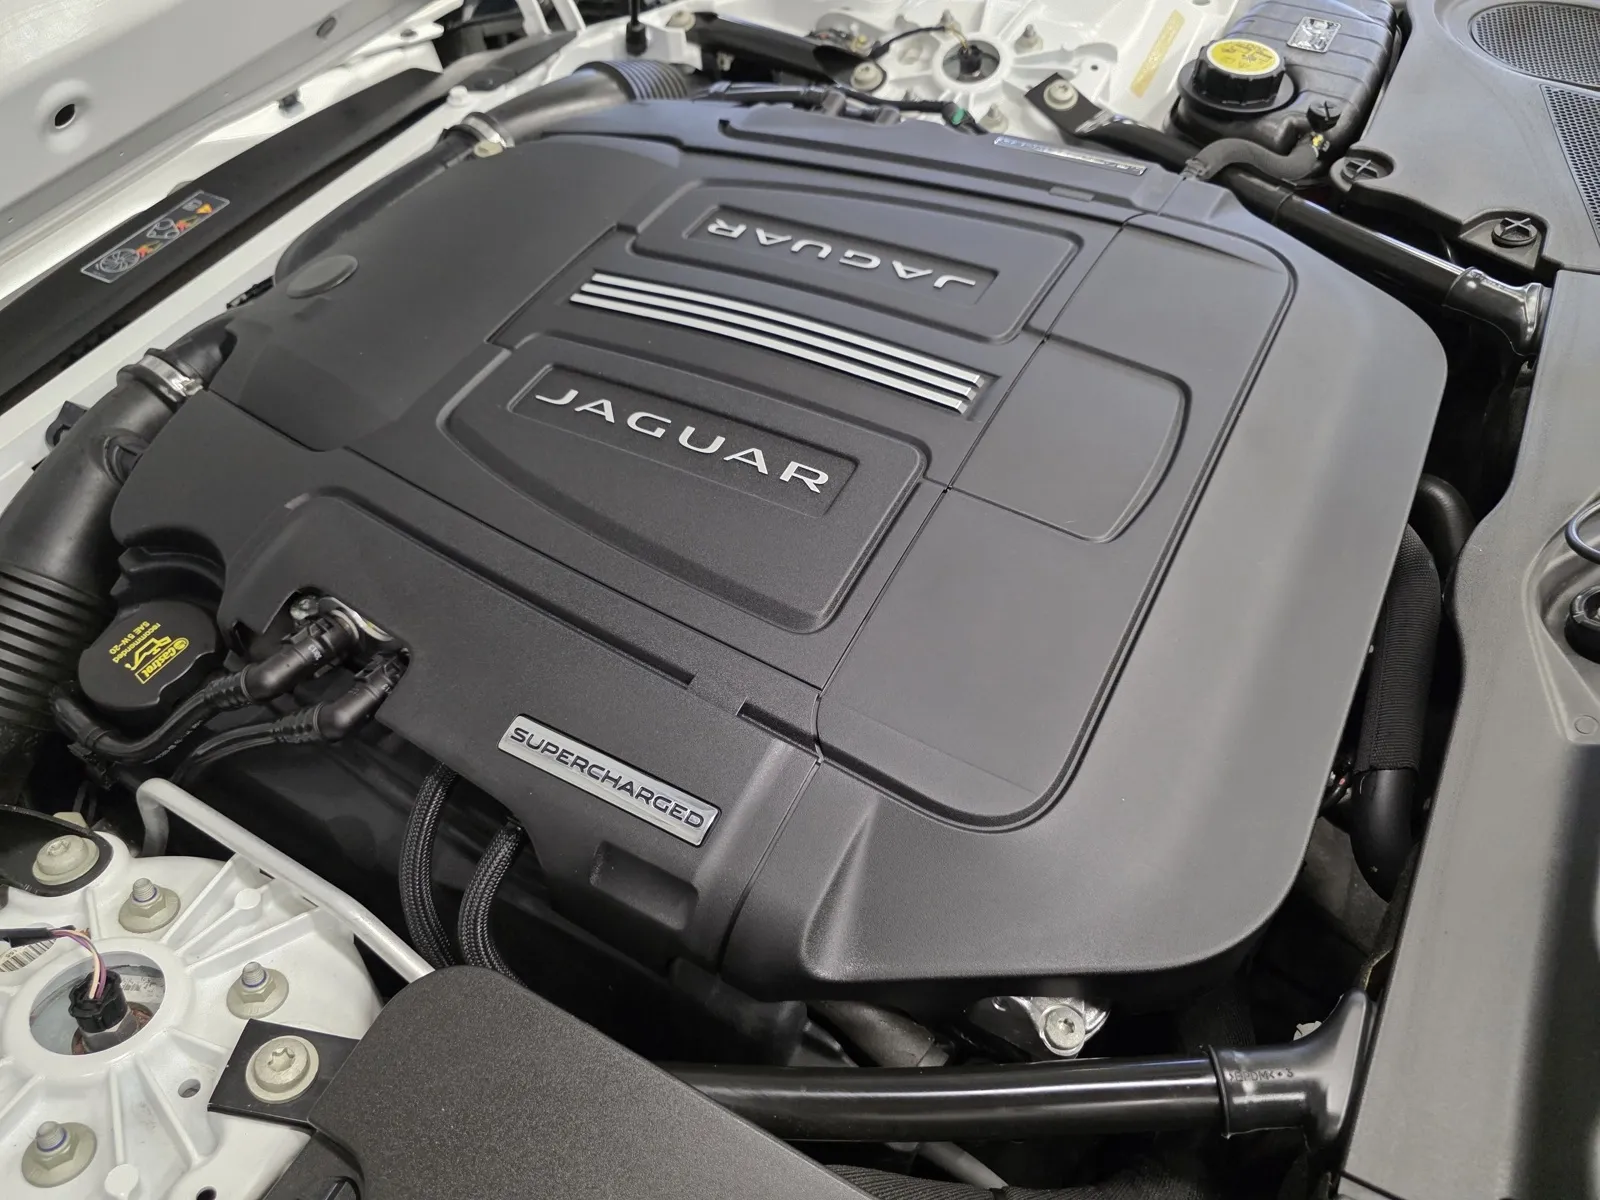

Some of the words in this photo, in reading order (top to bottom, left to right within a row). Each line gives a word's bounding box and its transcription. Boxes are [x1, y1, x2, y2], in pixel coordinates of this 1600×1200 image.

[707, 218, 976, 288] JAGUAR
[535, 389, 829, 493] JAGUAR
[112, 622, 161, 664] recommended
[133, 621, 150, 636] SAE
[141, 645, 177, 678] Castrol
[510, 727, 704, 828] SUPERCHARGED
